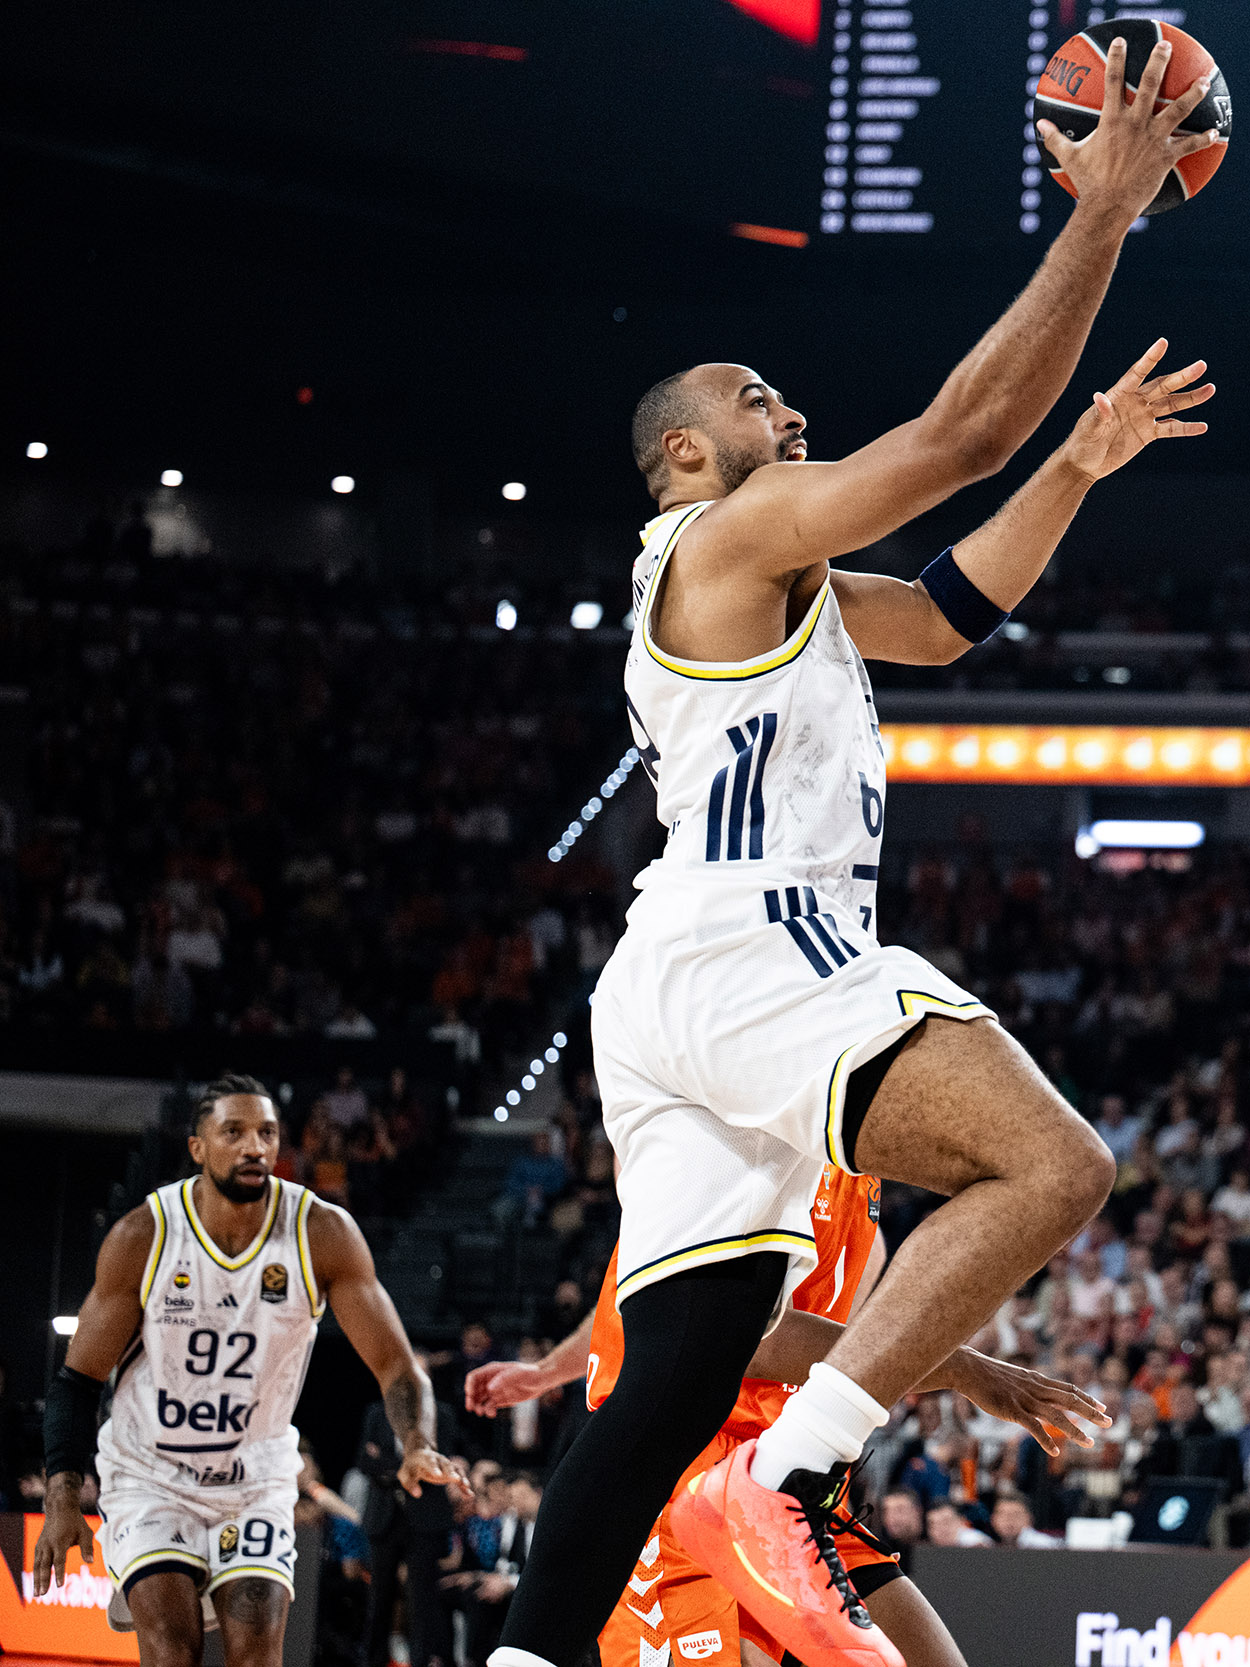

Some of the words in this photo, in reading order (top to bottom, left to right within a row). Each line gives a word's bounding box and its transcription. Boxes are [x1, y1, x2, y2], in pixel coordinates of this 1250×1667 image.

[185, 1328, 257, 1379] 92
[682, 1637, 719, 1651] PULEVA
[1075, 1612, 1172, 1667] Find
